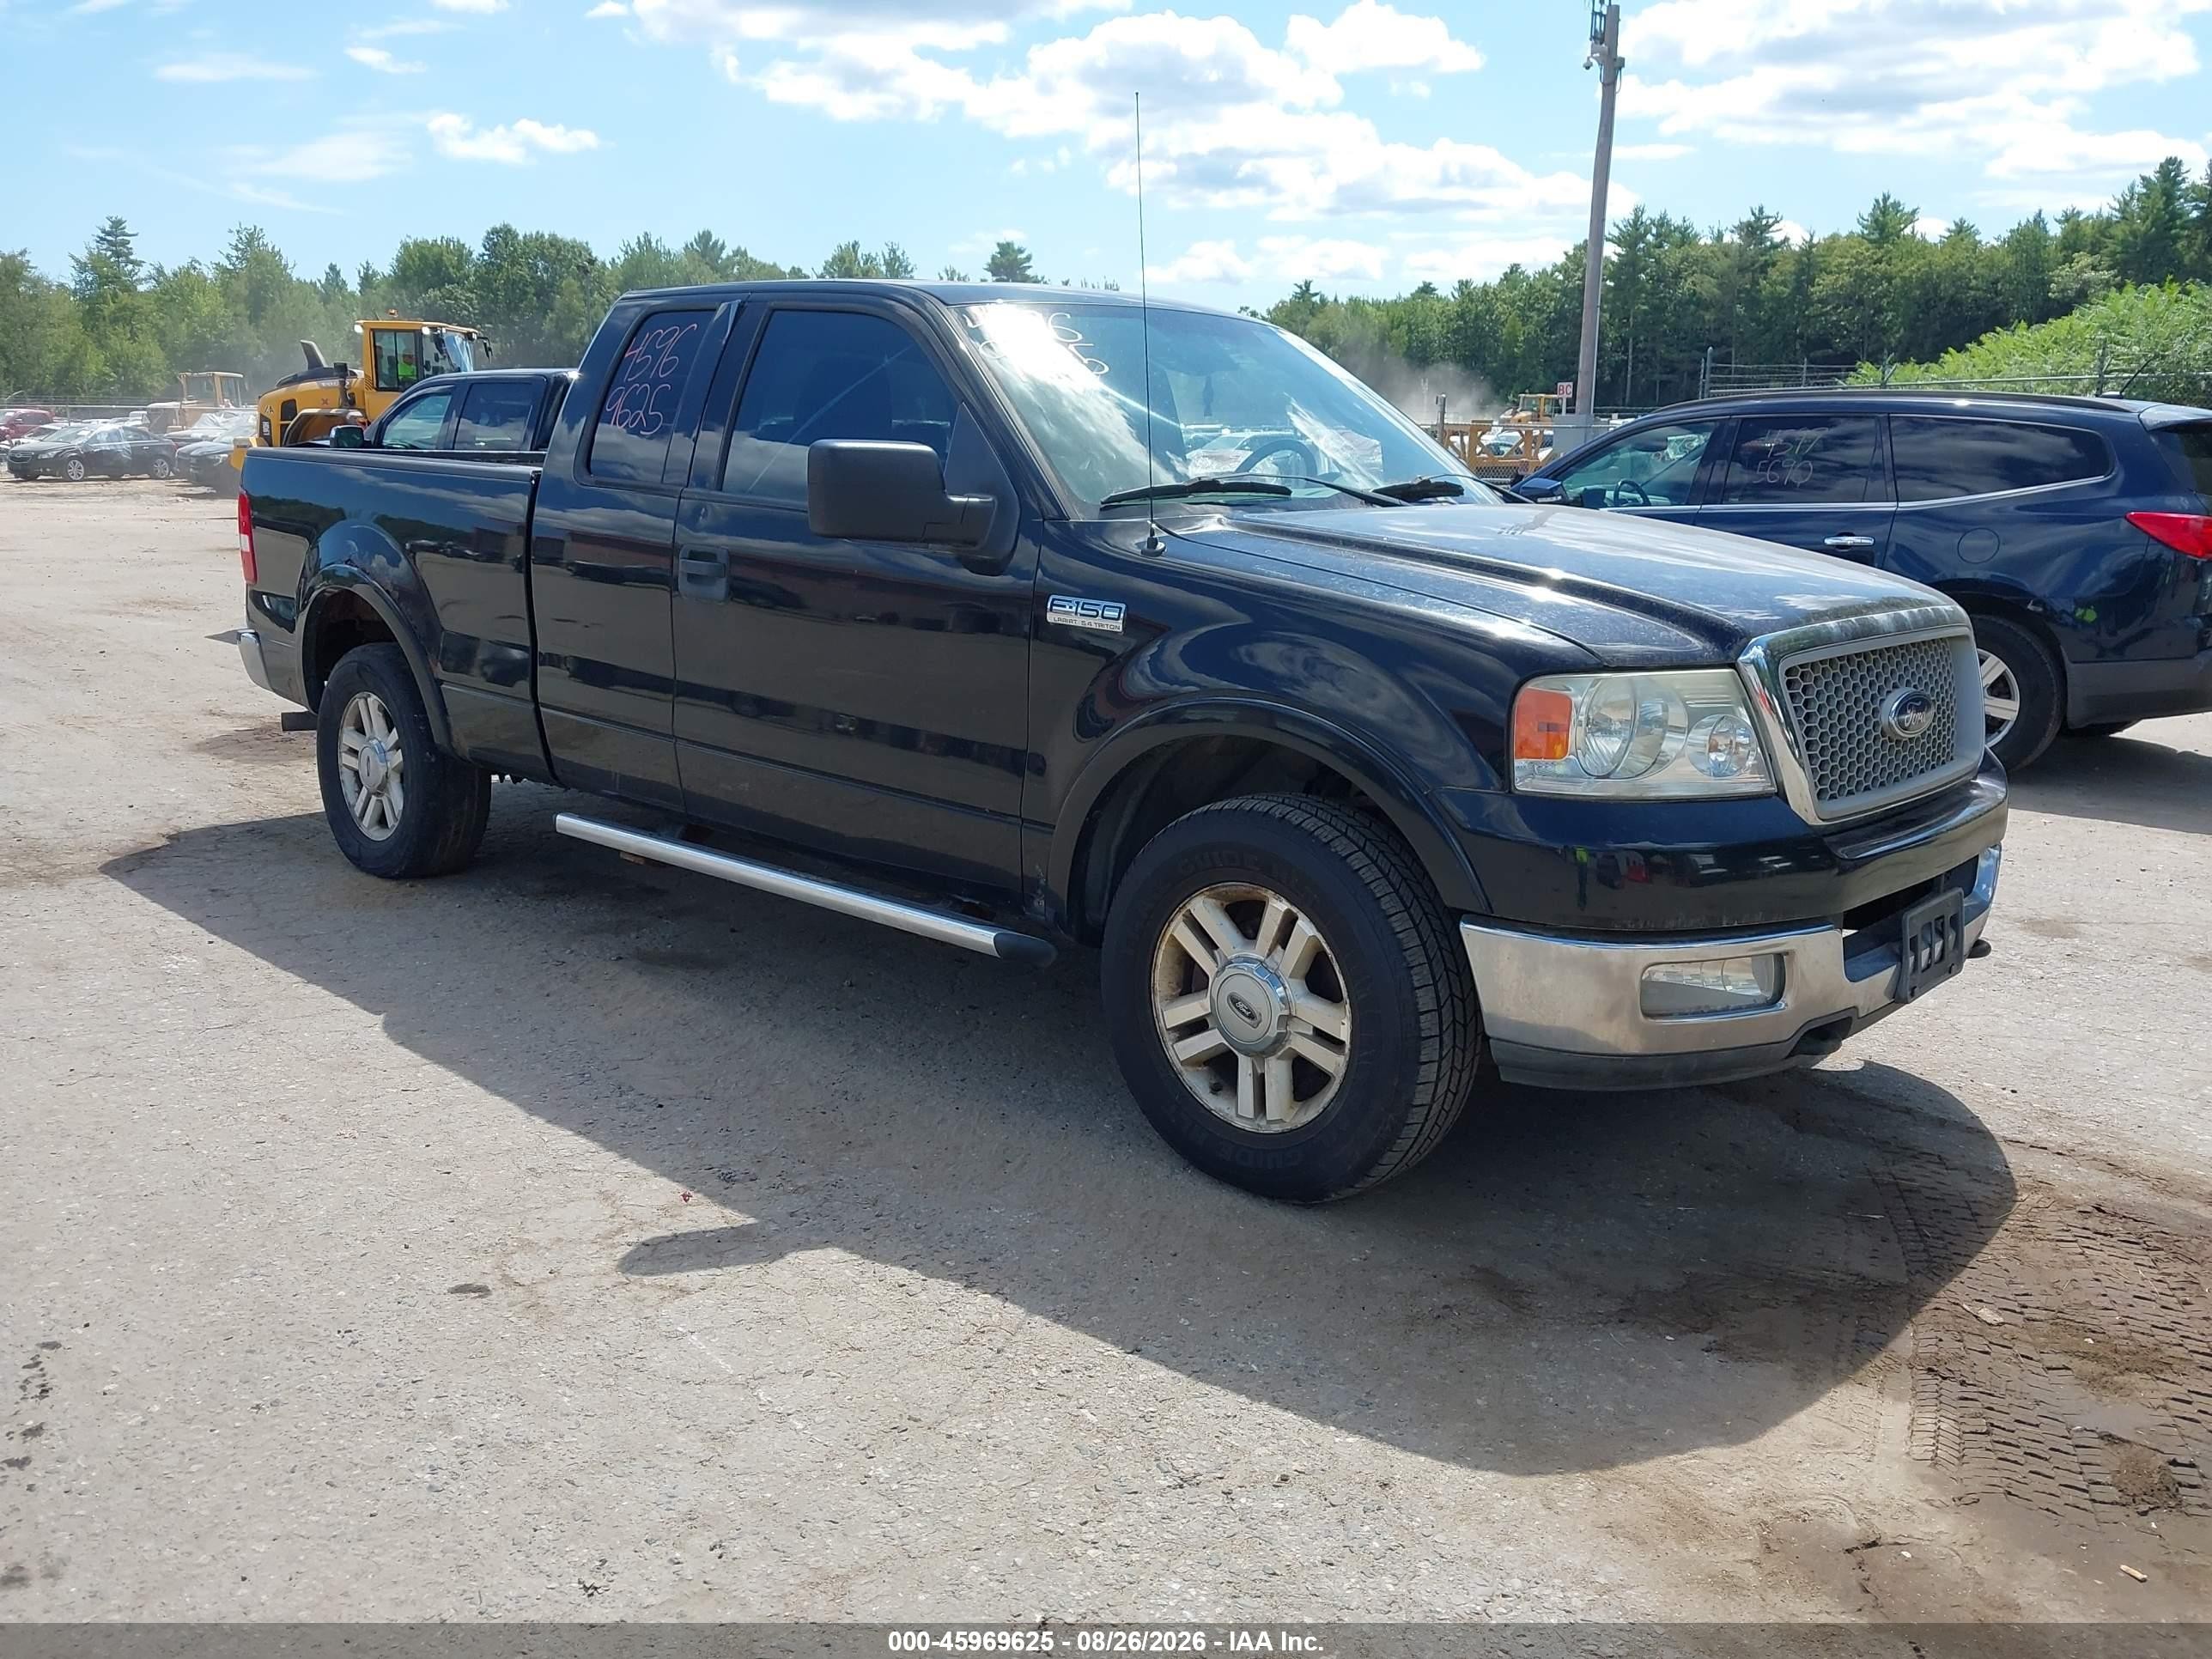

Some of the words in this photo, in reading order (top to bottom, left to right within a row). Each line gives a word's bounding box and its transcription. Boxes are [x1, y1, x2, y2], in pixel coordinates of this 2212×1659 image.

[623, 323, 697, 382] 4596
[1559, 384, 1571, 395] BC
[605, 383, 672, 435] 9625
[1752, 459, 1814, 488] 5690
[1049, 598, 1122, 621] F-150
[1904, 701, 1928, 727] Ford
